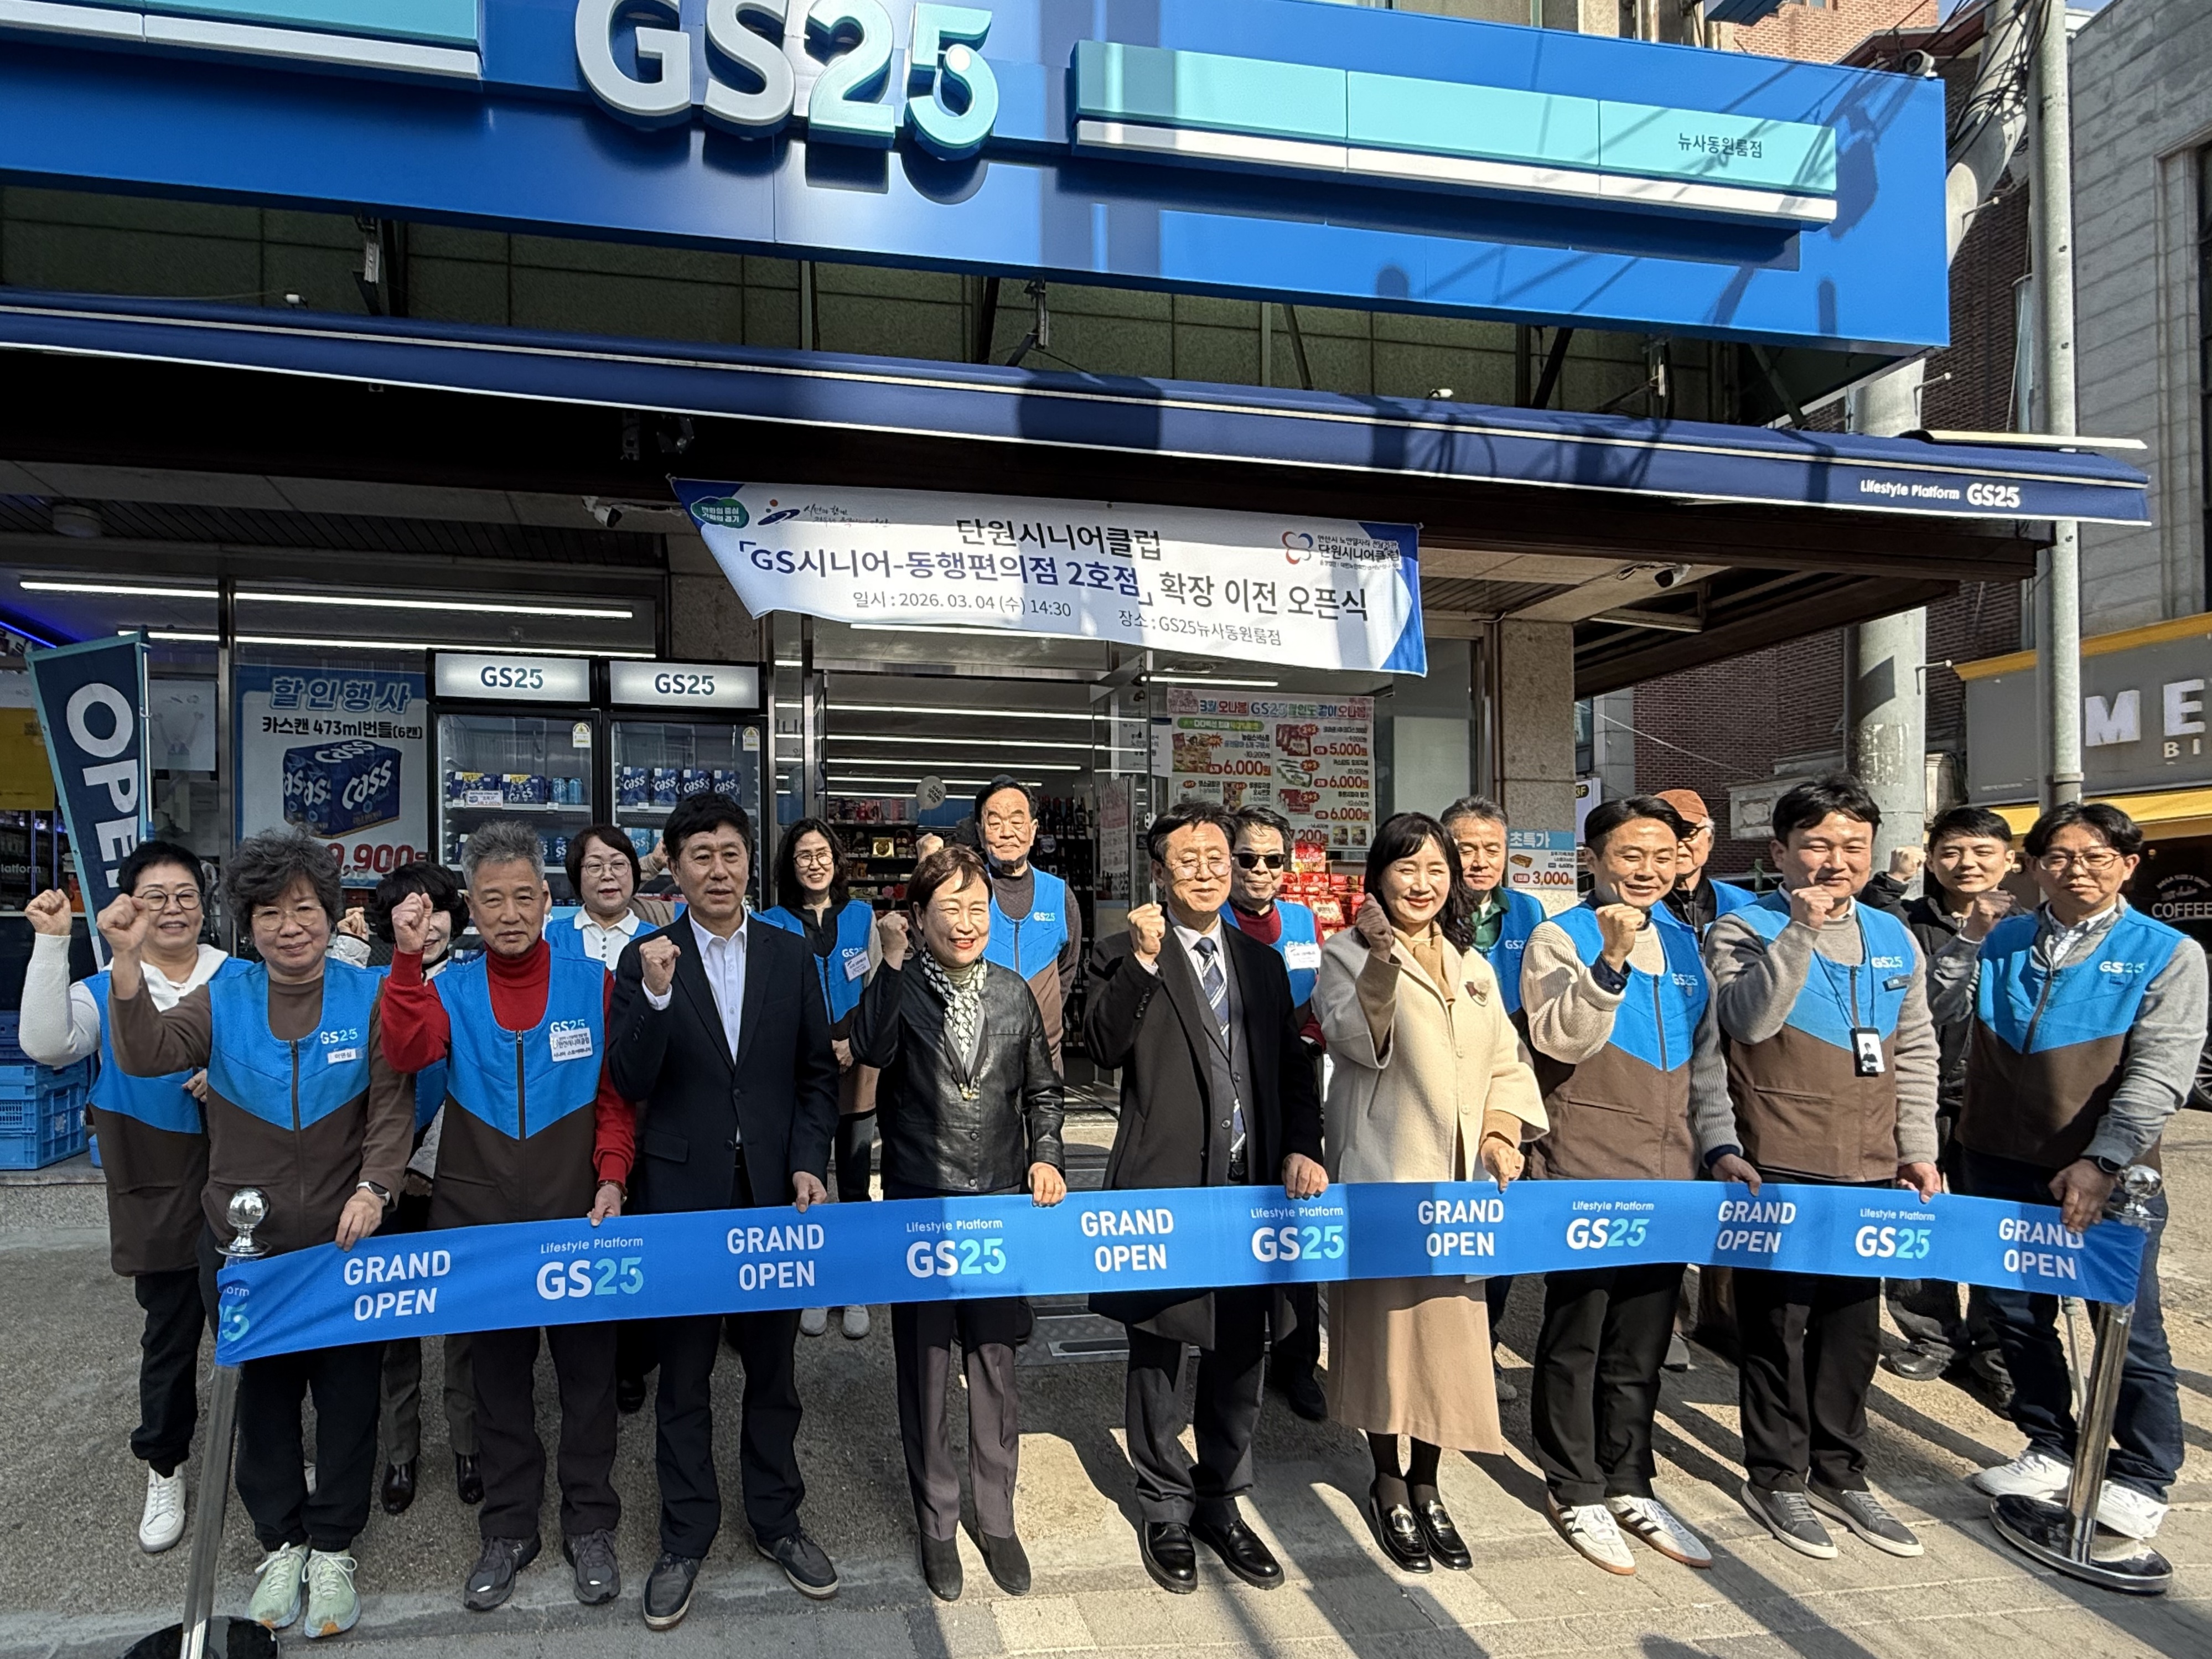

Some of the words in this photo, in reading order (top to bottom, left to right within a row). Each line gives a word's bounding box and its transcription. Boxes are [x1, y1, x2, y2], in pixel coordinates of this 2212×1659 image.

[575, 0, 999, 148] GS25
[1678, 133, 1763, 158] 뉴사동원룸점
[1860, 479, 1909, 497] Lifestyle
[1911, 484, 1960, 500] Platform
[1967, 483, 2021, 508] GS25
[956, 519, 1161, 561] 단원시니어클럽
[1318, 544, 1400, 562] 단원시니어클럽
[1030, 600, 1071, 617] 14:30
[1159, 571, 1215, 608] 확장
[1225, 578, 1278, 615] 이전
[1287, 585, 1368, 621] 오픈식
[480, 666, 543, 689] GS25
[655, 673, 715, 696] GS25
[270, 676, 412, 714] 할인행사
[262, 717, 309, 734] 카스캔
[313, 719, 423, 739] 473ml번들(6캔)
[66, 682, 139, 889] OPE
[1509, 831, 1551, 848] 초특가
[0, 863, 42, 874] latform
[1033, 911, 1055, 922] GS25
[2152, 902, 2212, 918] COFFEE
[1505, 939, 1527, 950] GS2
[1871, 956, 1903, 968] GS25
[2099, 961, 2146, 974] GS25
[1672, 973, 1698, 986] GS25
[320, 1028, 359, 1045] GS25
[550, 1019, 586, 1033] GS25
[1251, 1206, 1296, 1220] Lifestyle
[1298, 1205, 1344, 1219] Platform
[1418, 1199, 1504, 1225] GRAND
[1573, 1200, 1612, 1212] Lifestyle
[1615, 1201, 1654, 1211] Platform
[1717, 1200, 1797, 1225] GRAND
[1859, 1208, 1897, 1220] Lifestyle
[1899, 1209, 1936, 1222] Platform
[906, 1220, 952, 1233] Lifestyle
[956, 1218, 1003, 1231] Platform
[1080, 1209, 1174, 1237] GRAND
[1566, 1217, 1650, 1250] GS25
[1999, 1217, 2084, 1250] GRAND
[540, 1240, 589, 1254] Lifestyle
[594, 1236, 644, 1250] Platform
[726, 1224, 825, 1254] GRAND
[1251, 1225, 1345, 1263] GS25
[1426, 1231, 1495, 1258] OPEN
[1716, 1230, 1781, 1254] OPEN
[1855, 1226, 1932, 1260] GS25
[343, 1250, 451, 1285] GRAND
[906, 1237, 1007, 1278] GS25
[1095, 1243, 1168, 1273] OPEN
[2003, 1248, 2077, 1280] OPEN
[536, 1256, 644, 1300] GS25
[739, 1261, 815, 1291] OPEN
[354, 1288, 438, 1321] OPEN
